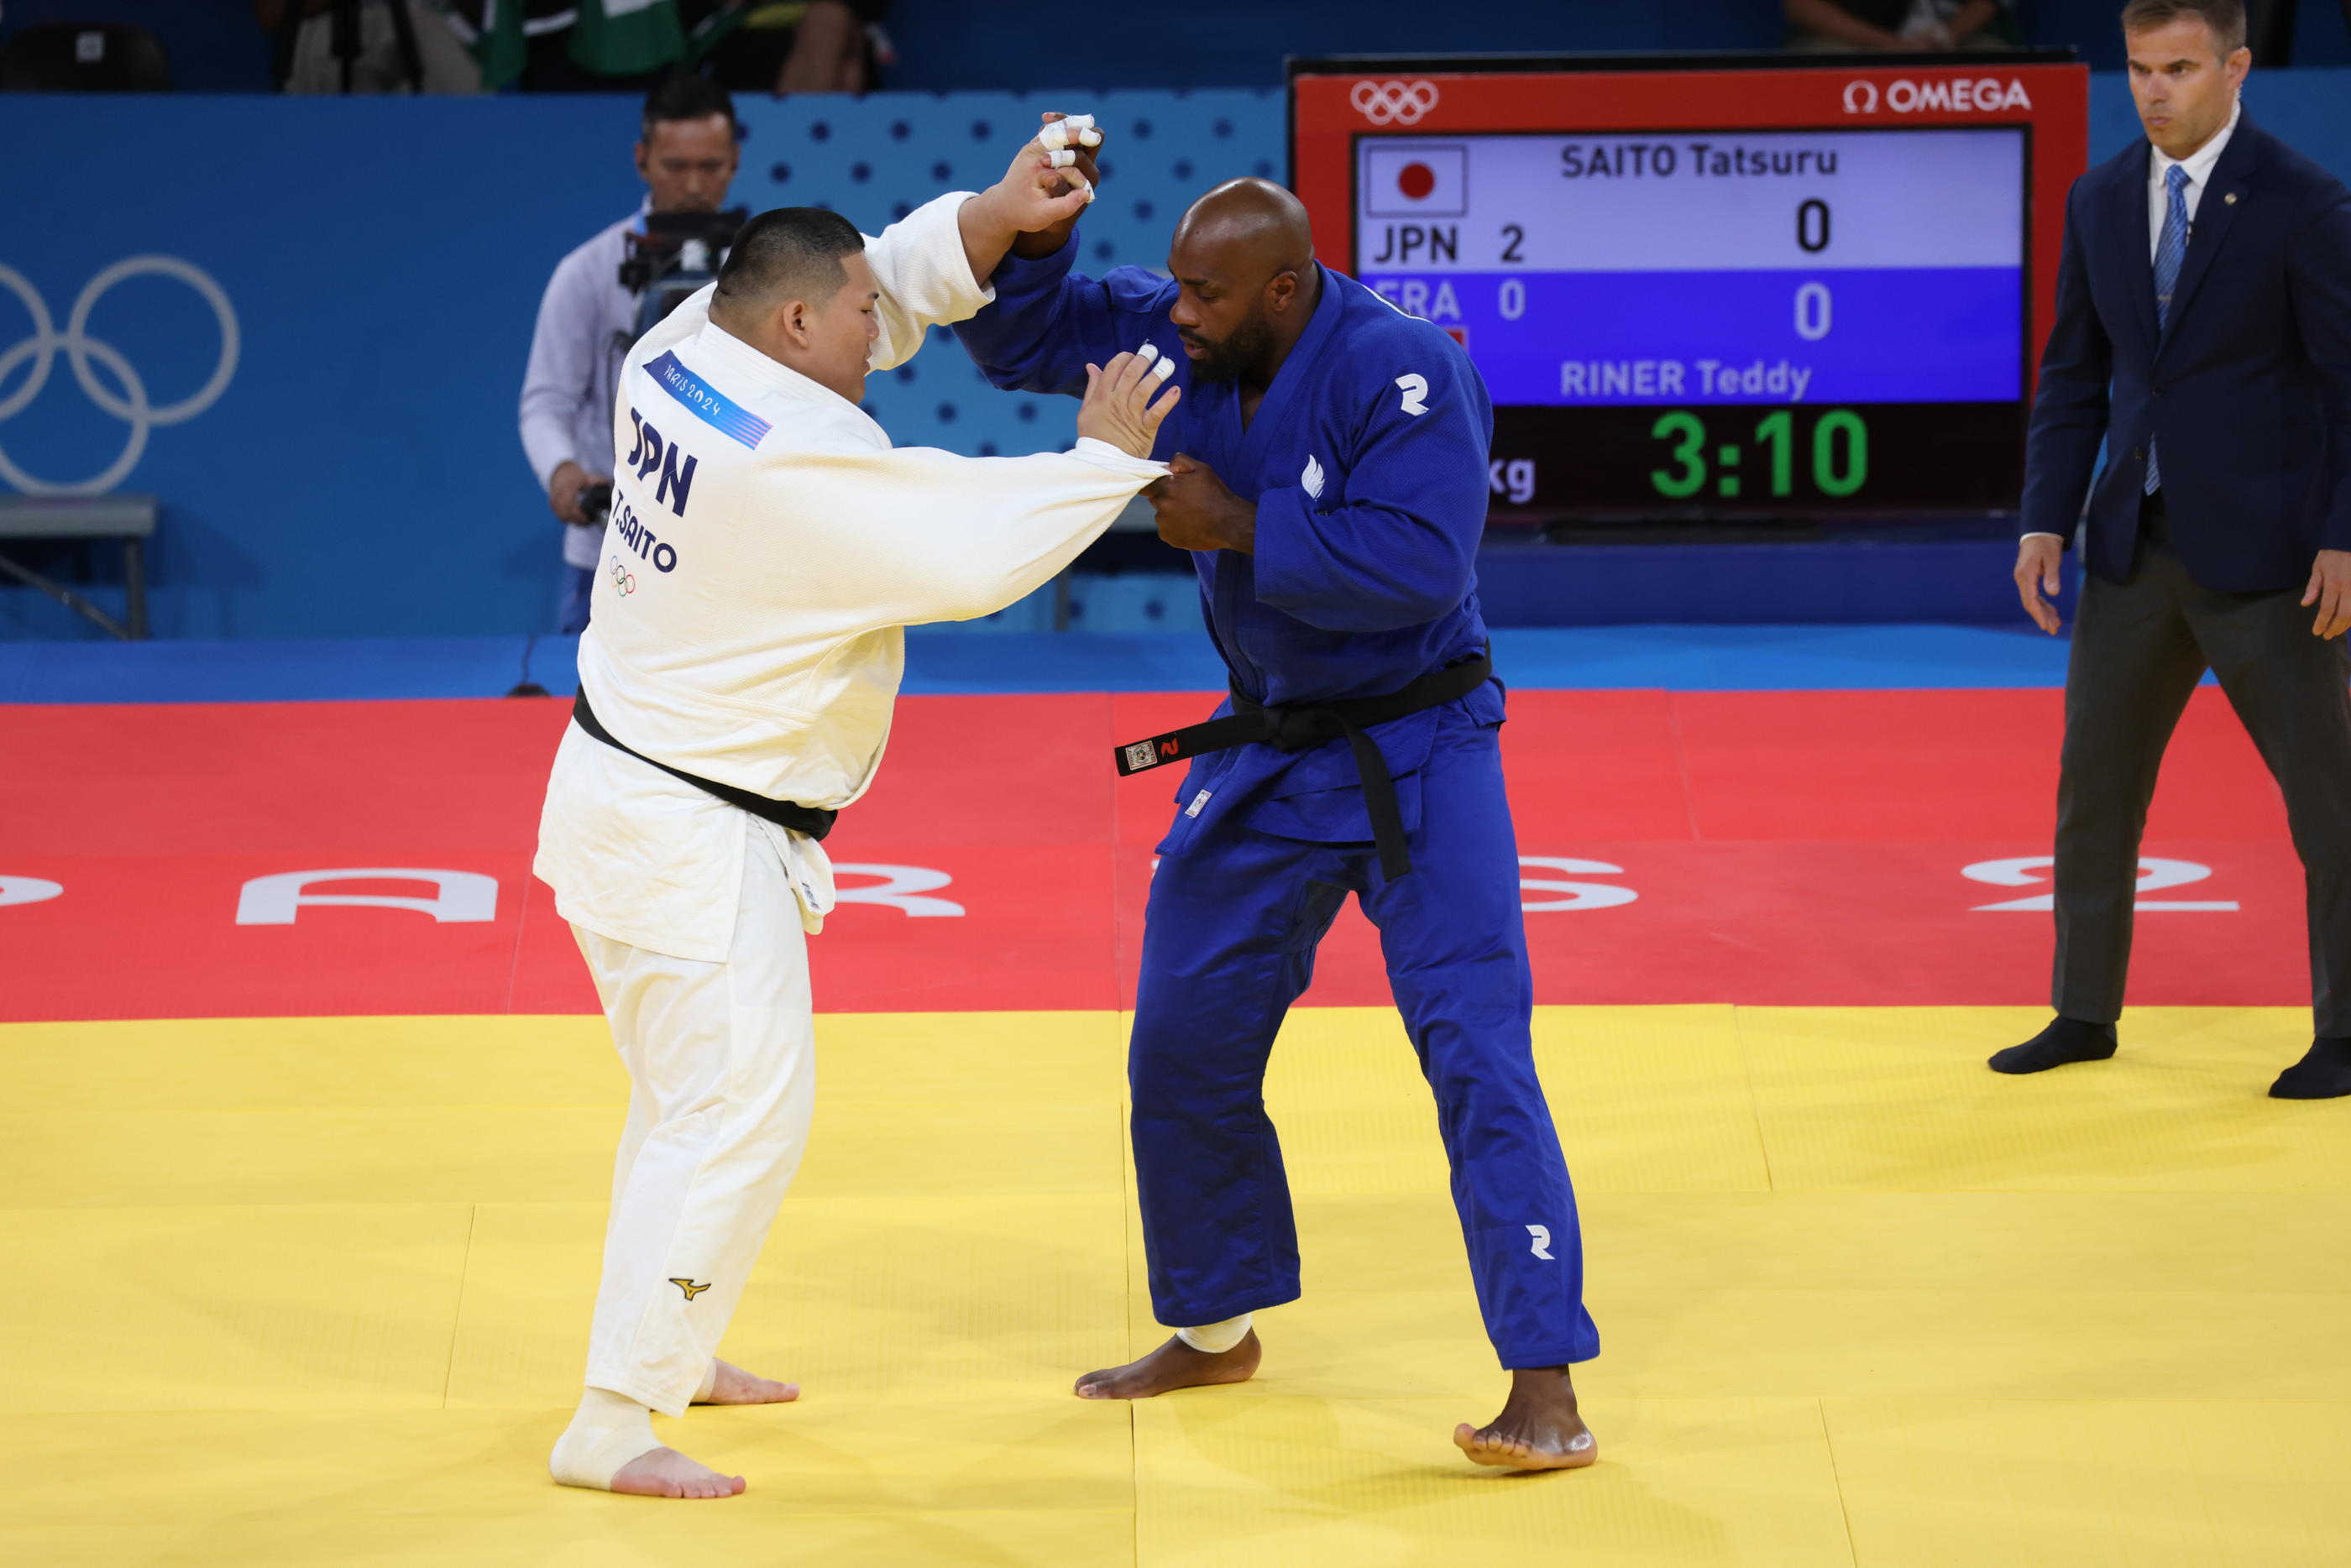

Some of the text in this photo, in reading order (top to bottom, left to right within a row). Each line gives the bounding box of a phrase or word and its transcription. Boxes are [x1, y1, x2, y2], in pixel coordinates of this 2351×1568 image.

[1887, 78, 2031, 112] OMEGA
[1560, 144, 1838, 178] SAITO Tatsuru
[1374, 197, 1831, 264] JPN 2 0
[1499, 279, 1526, 321] 0
[1793, 281, 1832, 342] 0
[686, 384, 721, 416] 2024
[1561, 360, 1811, 402] RINER Teddy
[627, 406, 699, 518] JPN
[1651, 410, 1868, 499] 3:10
[610, 488, 678, 573] T.SAITO
